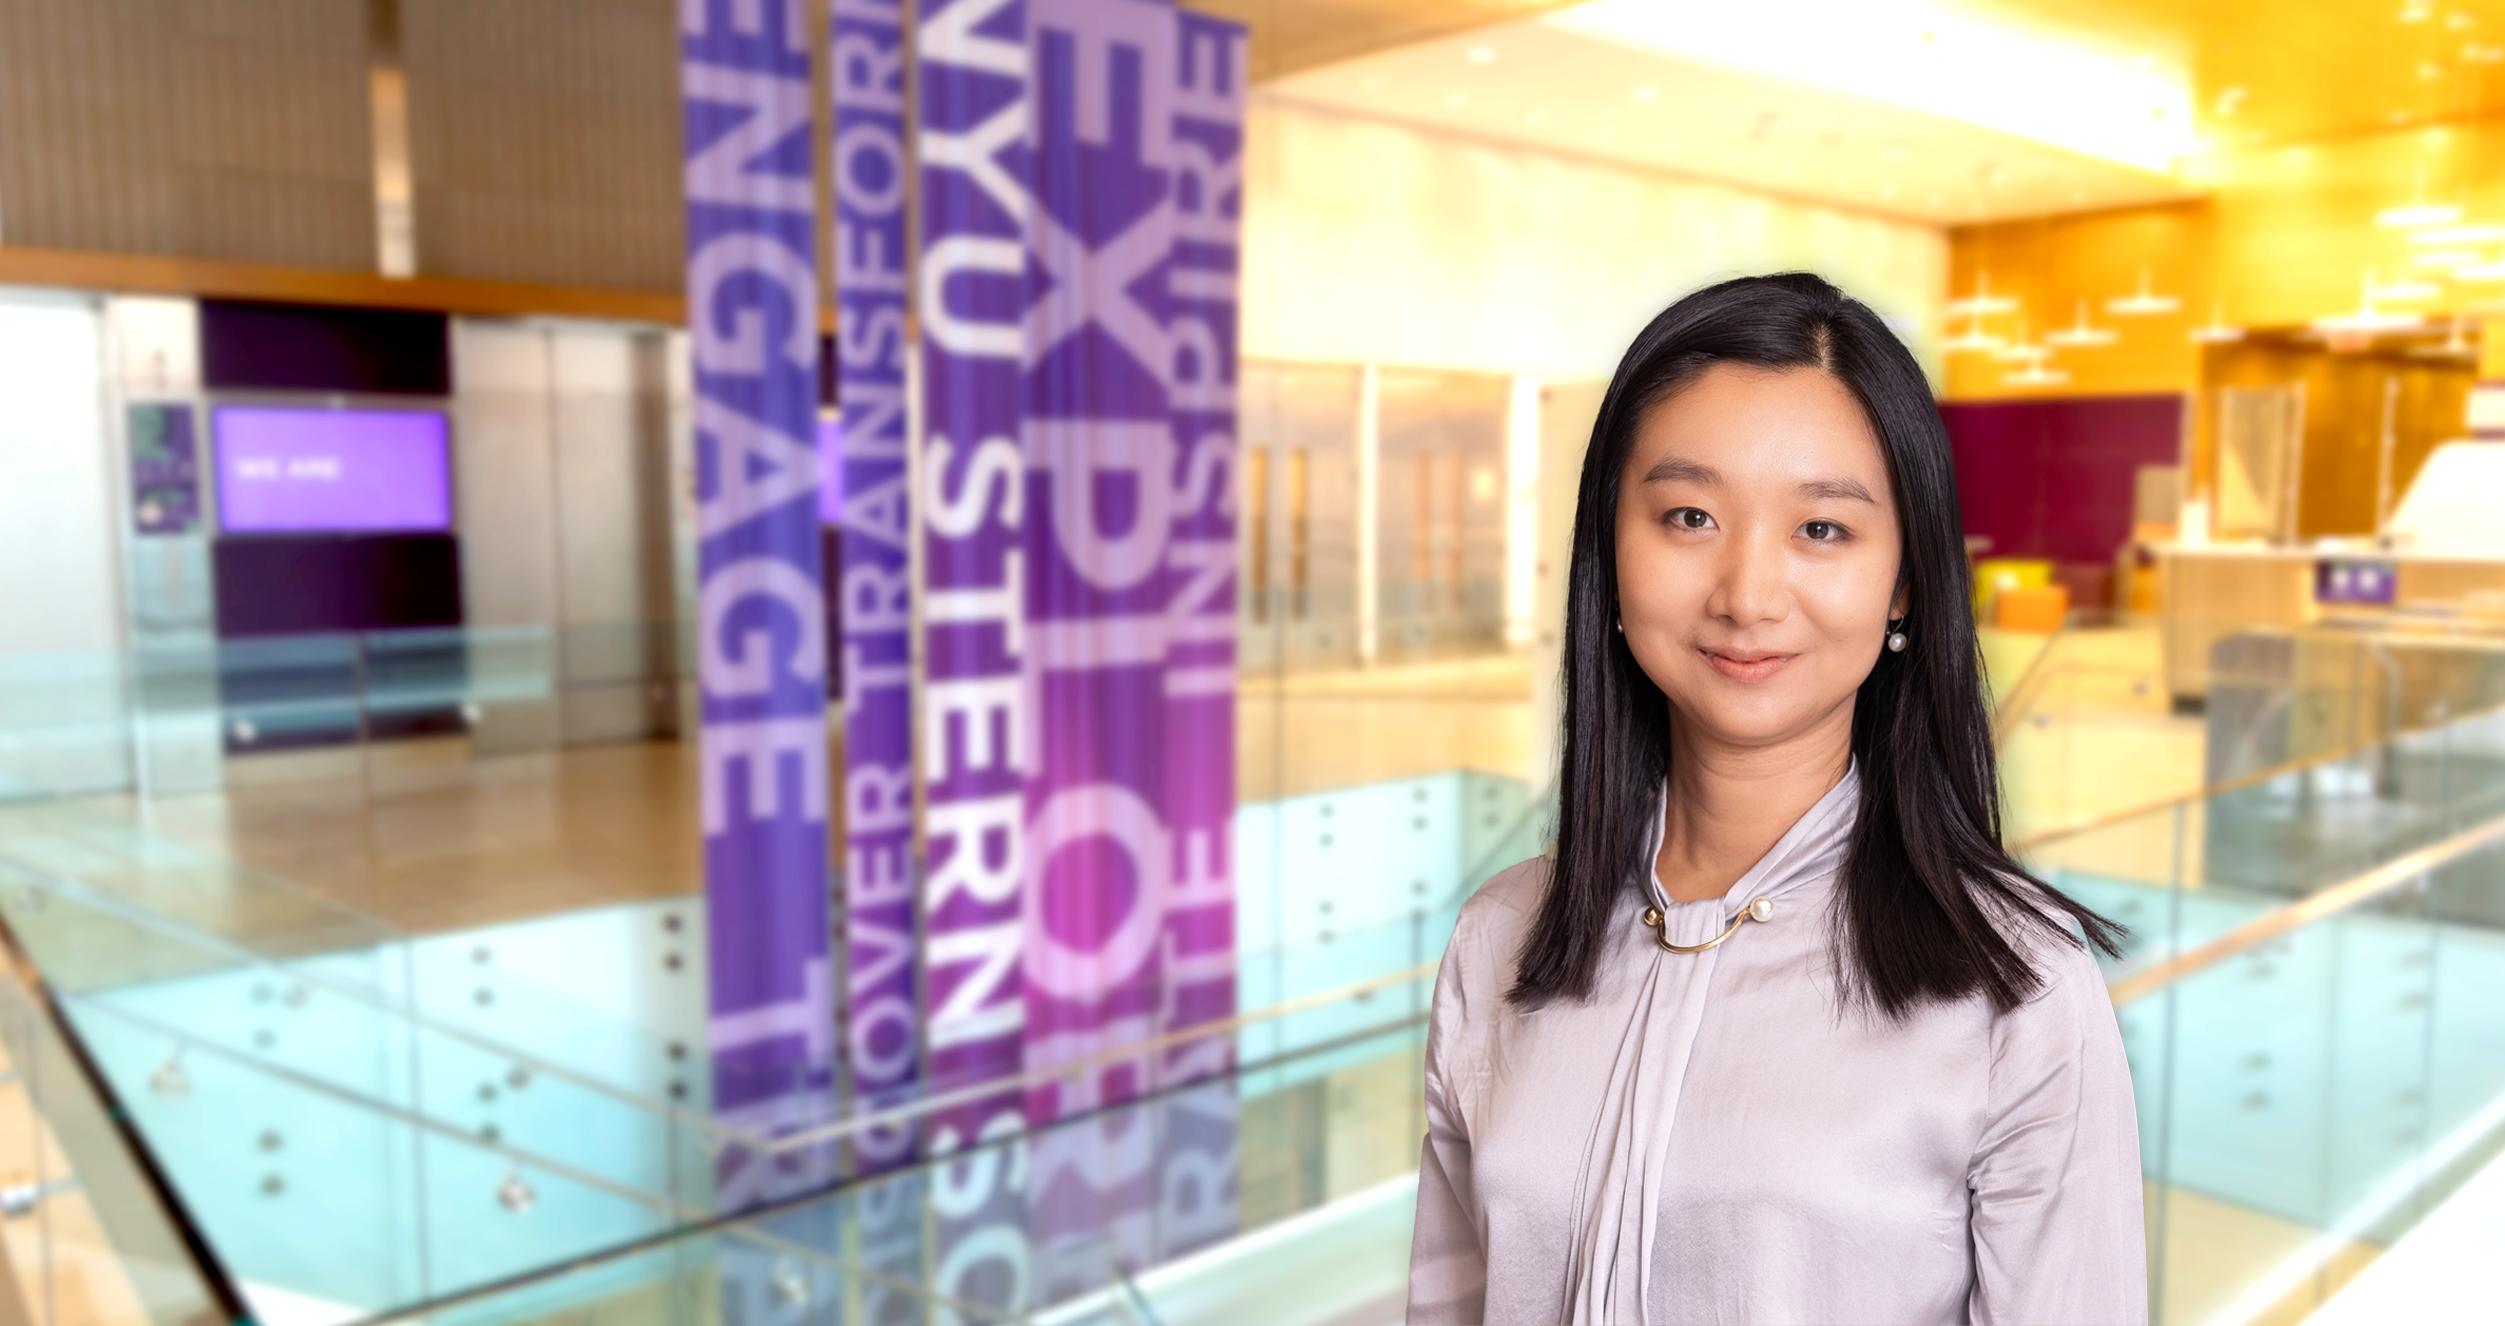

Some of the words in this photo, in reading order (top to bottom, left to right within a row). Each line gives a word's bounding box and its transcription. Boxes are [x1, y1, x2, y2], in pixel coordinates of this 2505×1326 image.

[831, 0, 911, 711] TRANSFOR
[918, 0, 1028, 358] NYU
[1163, 36, 1245, 697] INSPIRE
[922, 436, 1026, 1048] STERN
